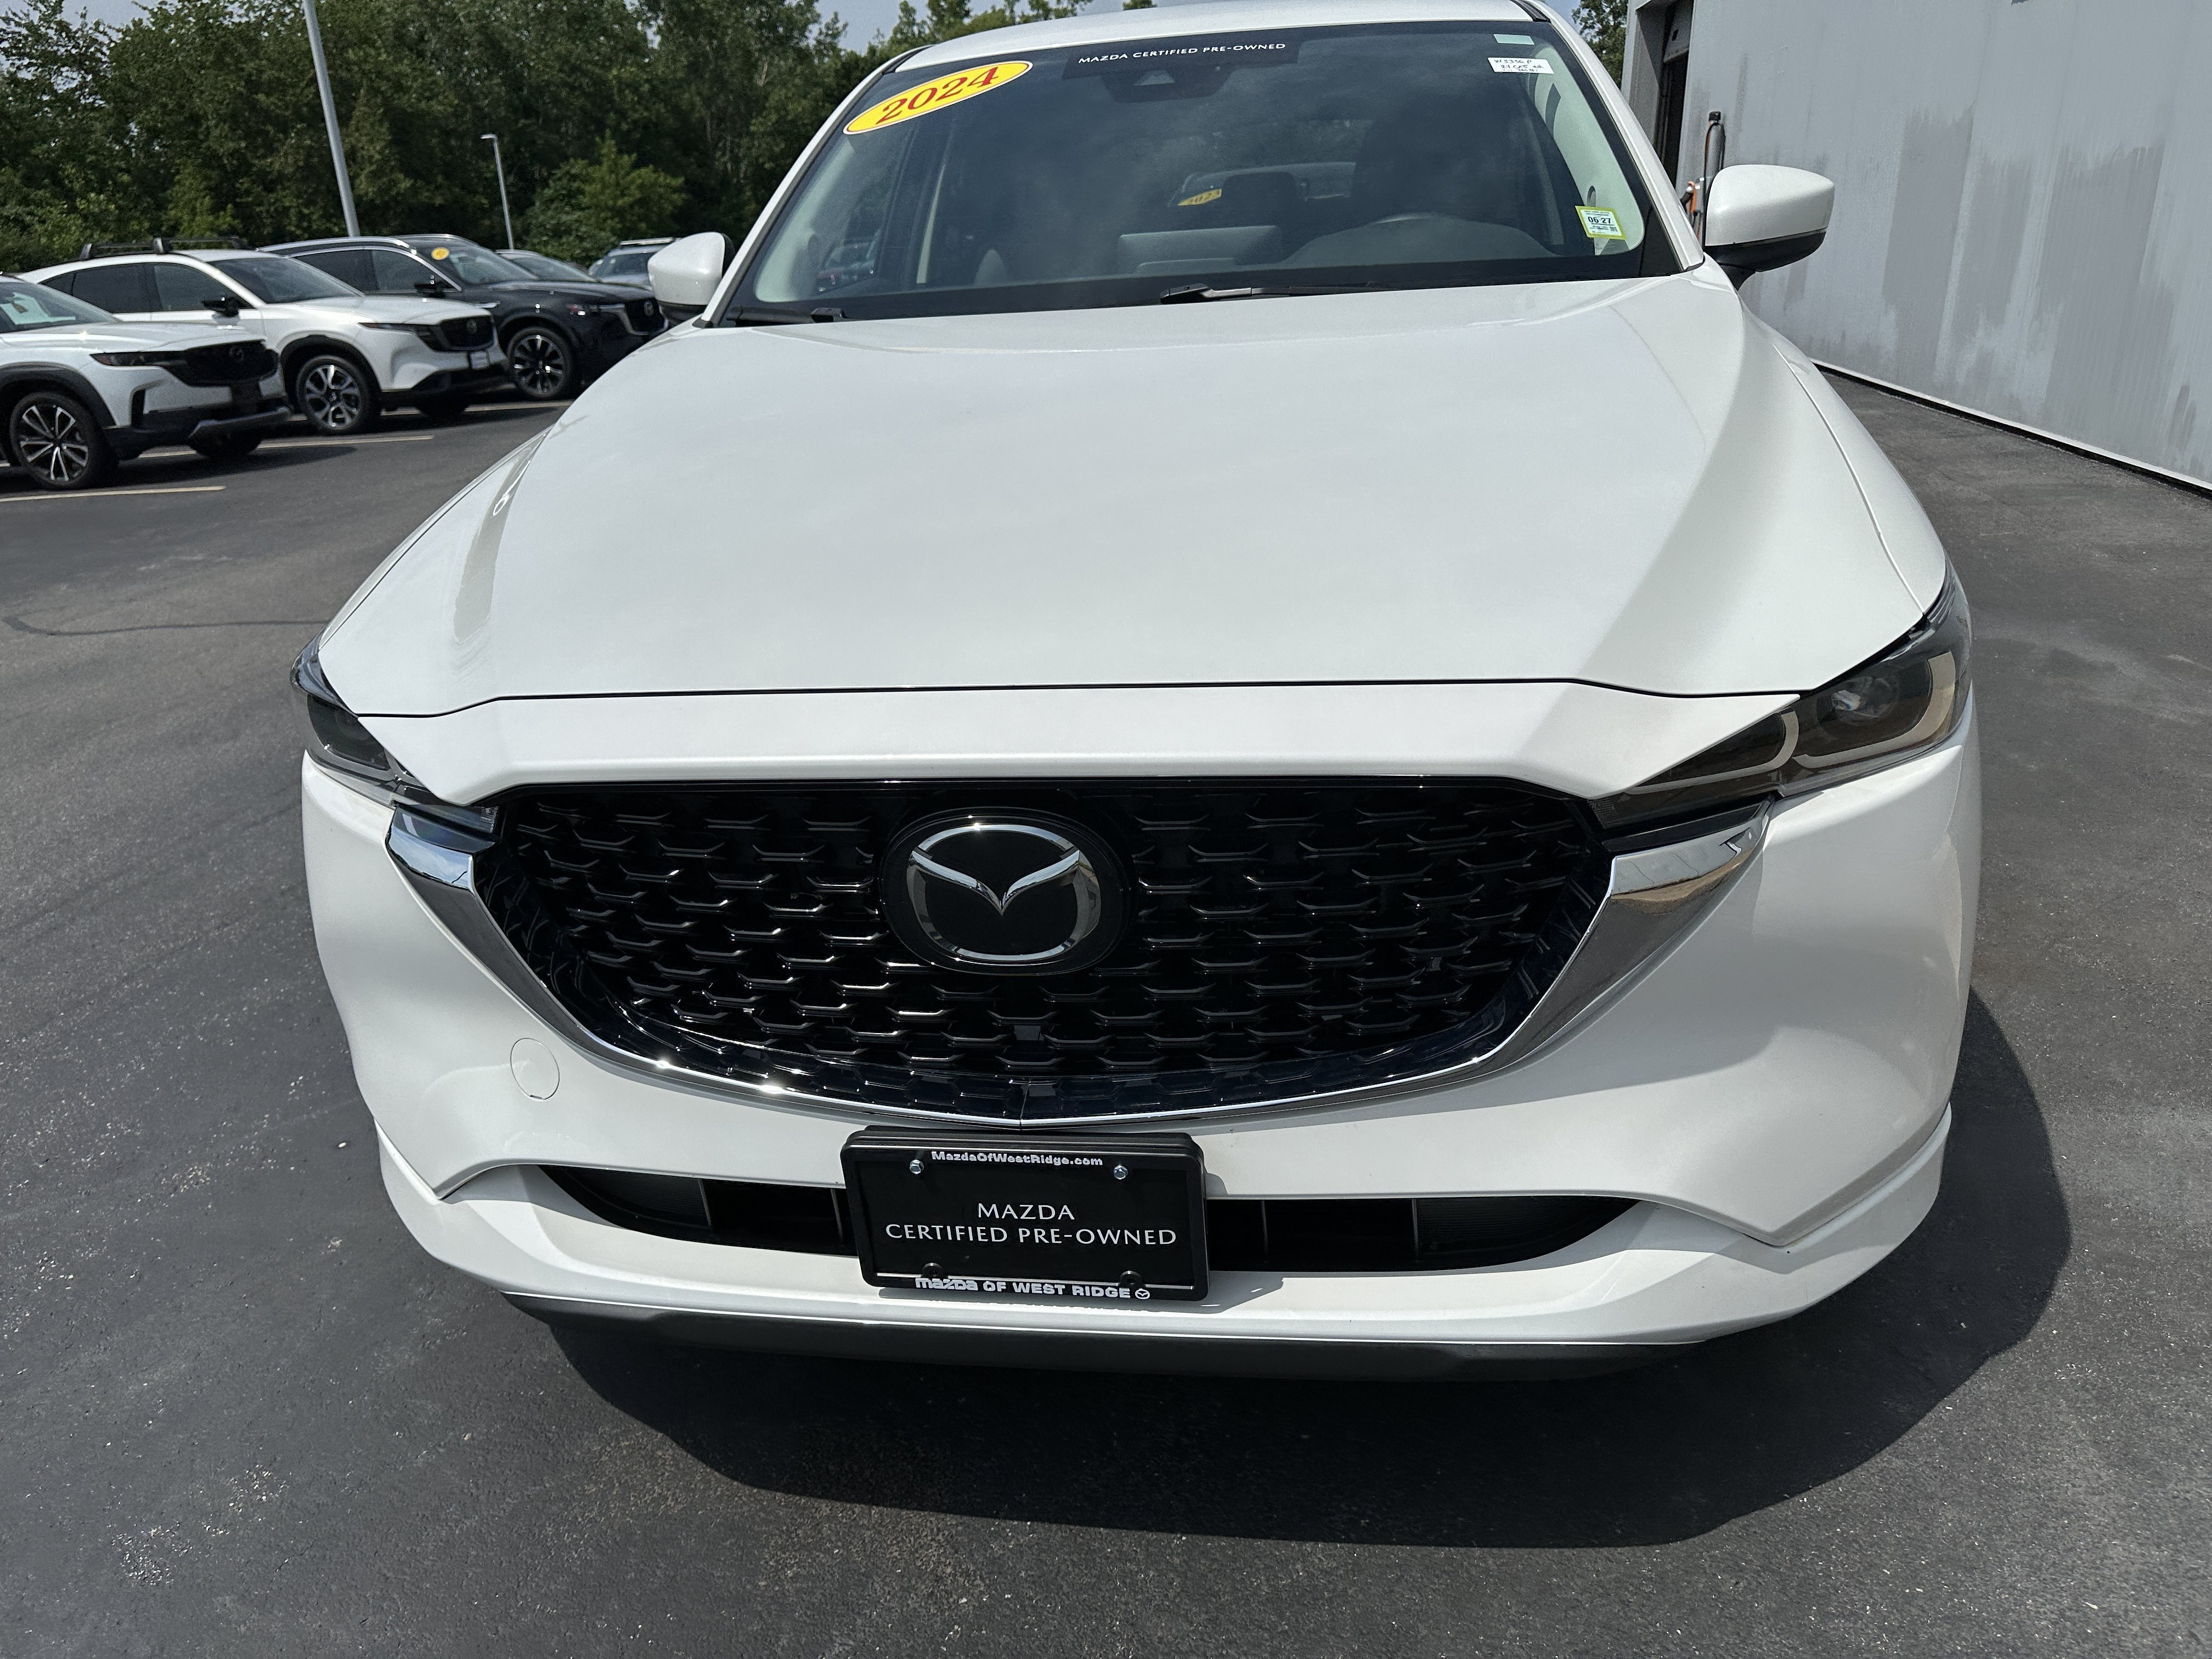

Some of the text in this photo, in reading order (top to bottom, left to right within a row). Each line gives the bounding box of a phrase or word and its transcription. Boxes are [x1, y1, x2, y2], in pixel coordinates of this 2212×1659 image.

[1078, 43, 1286, 64] MAZDA CERTIFIED PRE-OWNED
[875, 66, 999, 125] 2024
[931, 1151, 1103, 1166] MazdaOfWestRidge.com
[978, 1203, 1075, 1220] MAZDA
[885, 1223, 1177, 1245] CERTIFIED PRE-OWNED
[983, 1281, 1007, 1293] OF
[1013, 1283, 1066, 1295] WEST
[1071, 1285, 1131, 1299] RIDGE
